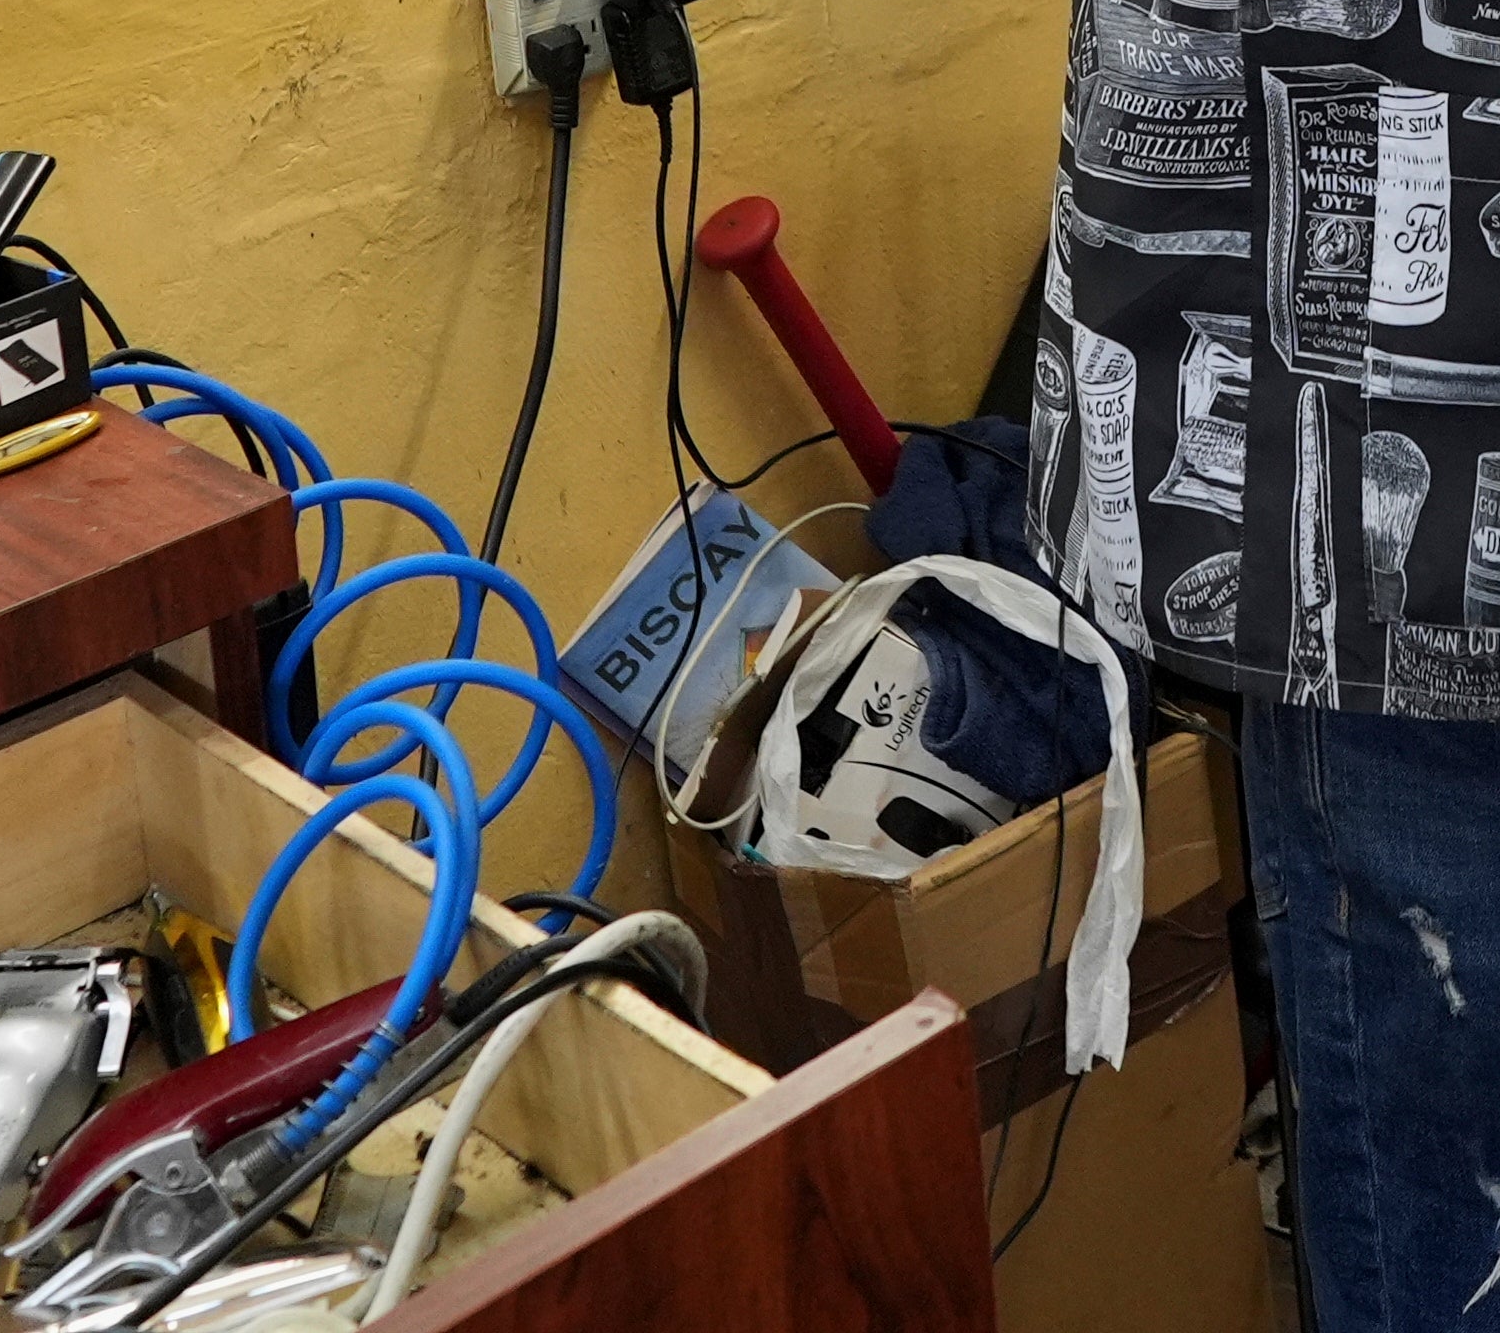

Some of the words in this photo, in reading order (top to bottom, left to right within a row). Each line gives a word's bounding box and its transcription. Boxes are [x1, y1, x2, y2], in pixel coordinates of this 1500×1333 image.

[1152, 30, 1192, 50] OUR
[1118, 39, 1180, 76] TRADE
[1182, 54, 1245, 80] MAR
[1195, 98, 1249, 119] BAR
[1135, 121, 1220, 134] MANUFACTURED
[1221, 122, 1238, 133] BY
[1409, 114, 1444, 132] STICK
[1234, 136, 1250, 157] &
[1300, 128, 1322, 141] OLD
[1326, 127, 1377, 146] RELIABLE
[1305, 146, 1377, 168] HAIR
[1312, 194, 1364, 212] DYE
[1295, 293, 1329, 316] SEARS
[1100, 414, 1131, 443] SOAP
[1101, 498, 1133, 517] STICK
[594, 503, 762, 694] BISCAY
[1173, 585, 1211, 610] STROP
[884, 683, 932, 752] Logitech
